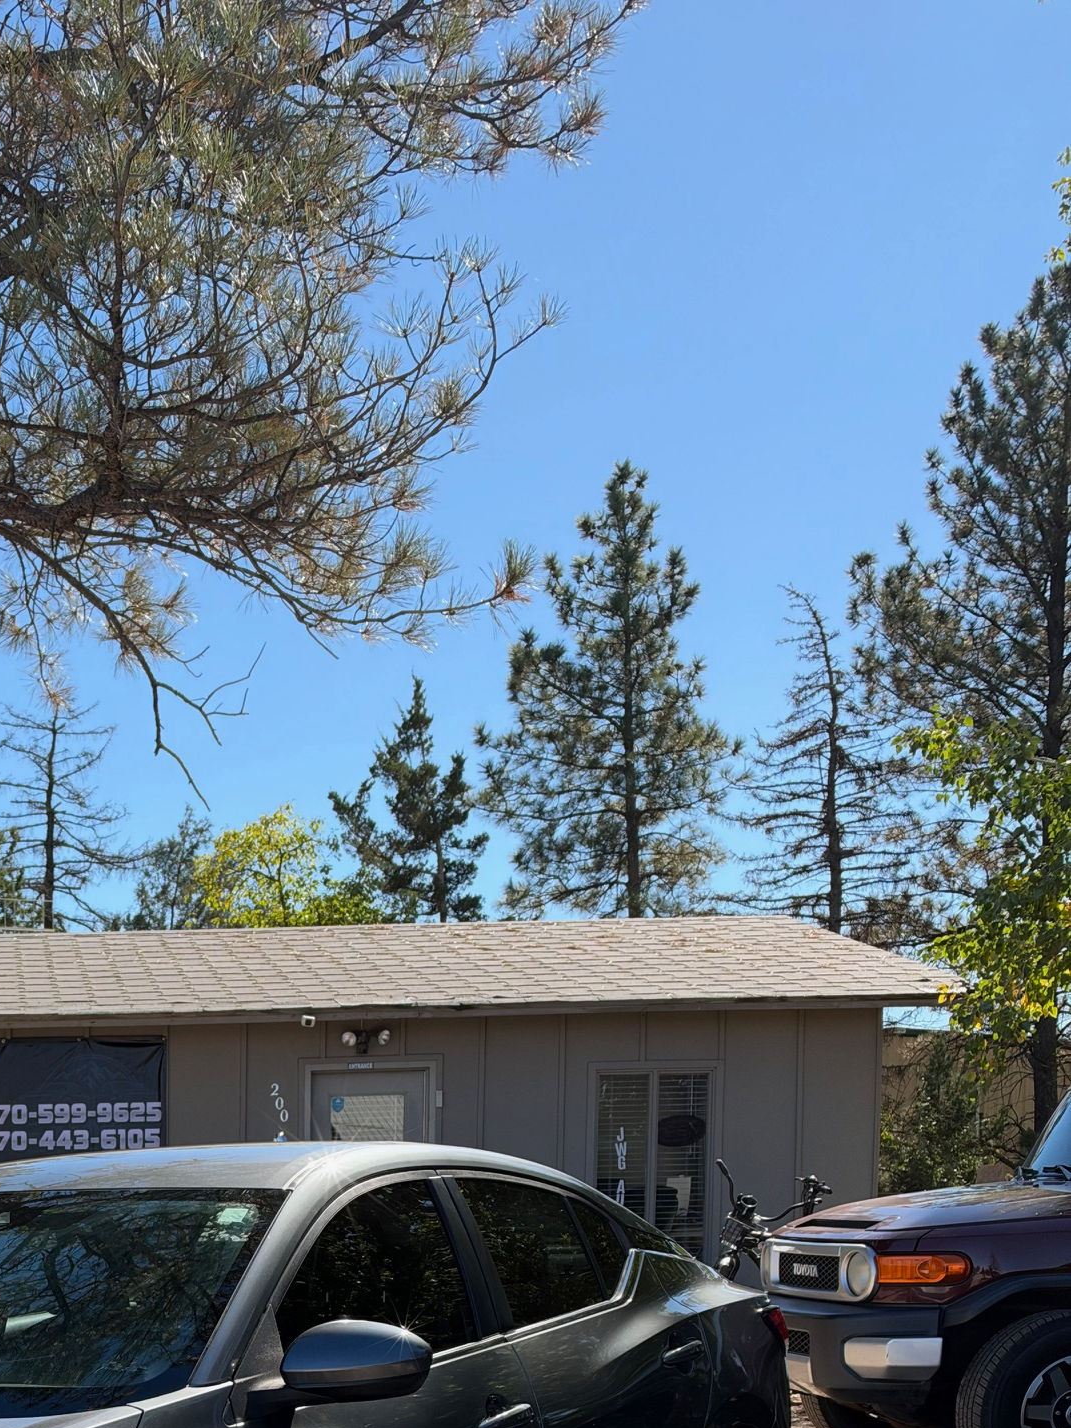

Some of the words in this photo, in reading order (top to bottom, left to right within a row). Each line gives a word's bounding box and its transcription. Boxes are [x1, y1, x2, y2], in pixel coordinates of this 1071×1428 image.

[348, 1062, 373, 1070] ENTRANCE
[270, 1083, 289, 1122] 200
[614, 1126, 627, 1171] JWG
[793, 1262, 819, 1278] TOYOTA
